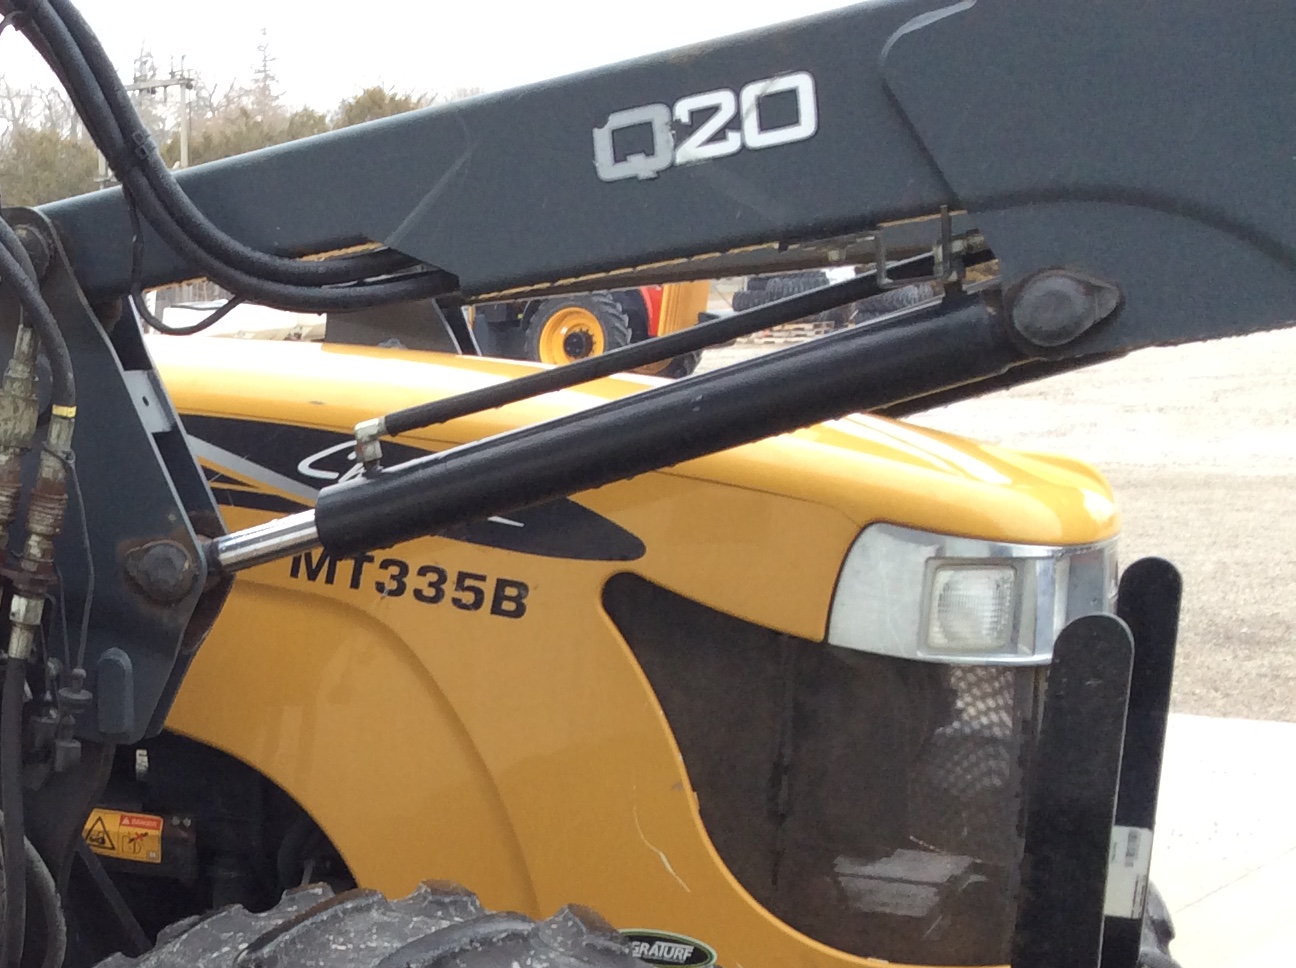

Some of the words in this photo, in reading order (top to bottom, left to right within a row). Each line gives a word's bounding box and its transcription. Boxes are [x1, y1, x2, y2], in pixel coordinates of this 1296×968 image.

[592, 70, 818, 183] Q20
[289, 550, 530, 619] MT335B
[631, 940, 695, 962] GRATURF
